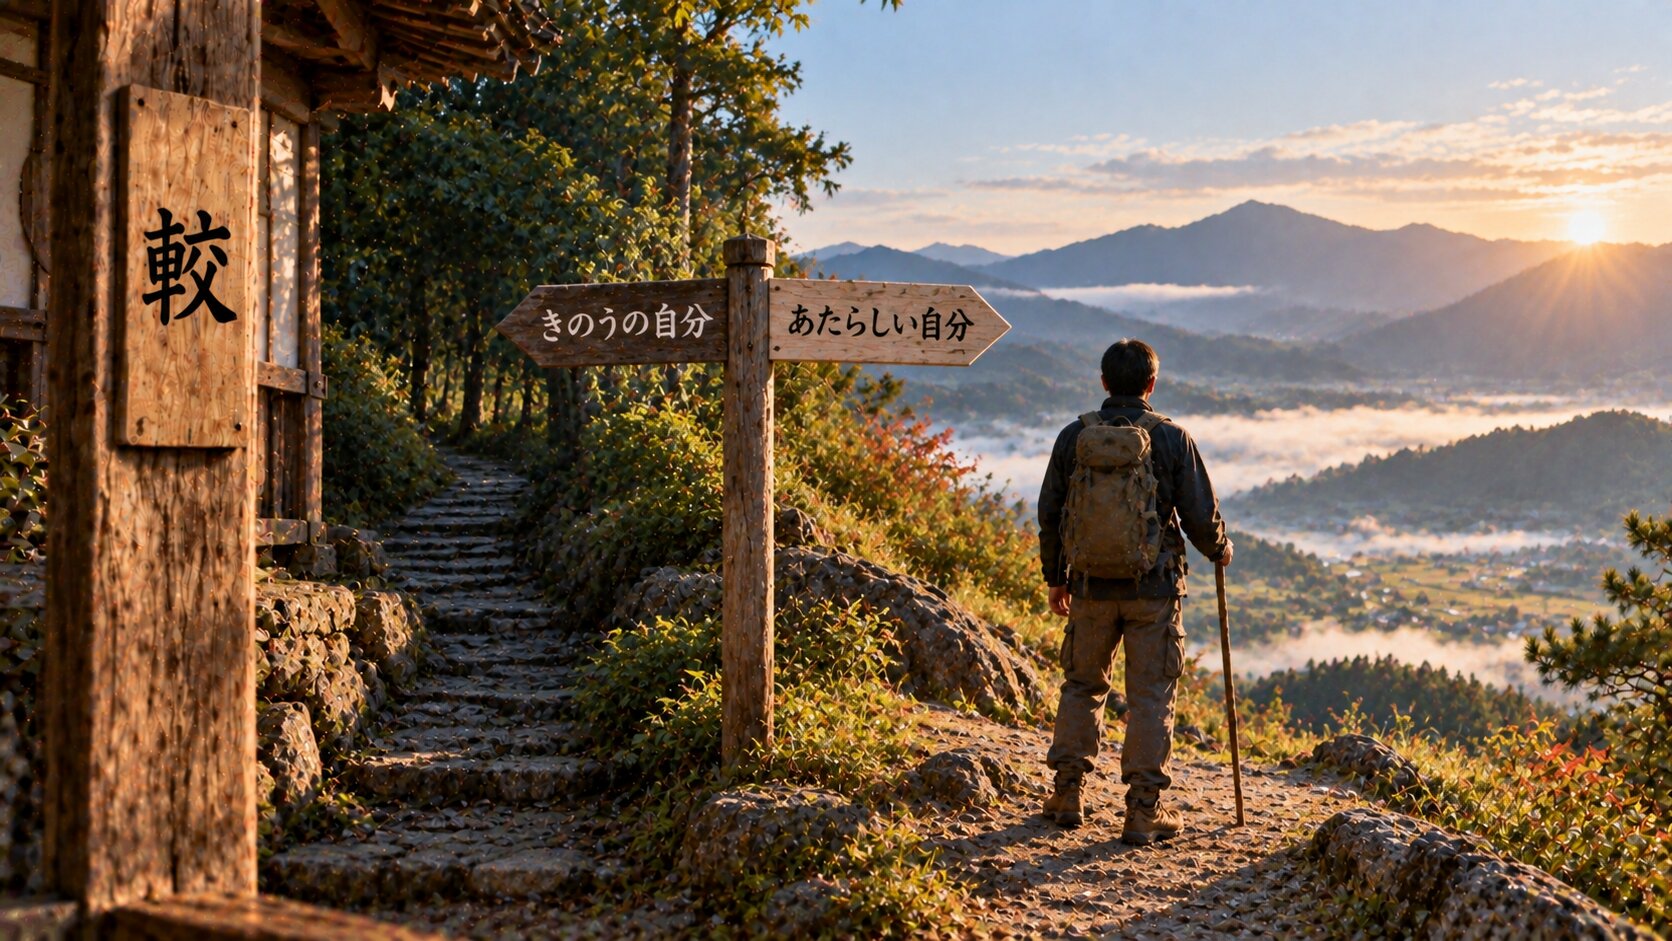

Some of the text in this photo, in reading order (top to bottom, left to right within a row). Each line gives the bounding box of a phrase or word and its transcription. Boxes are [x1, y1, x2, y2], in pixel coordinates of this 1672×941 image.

[142, 207, 238, 326] 較
[540, 303, 714, 342] きのうの自分
[788, 303, 975, 342] あたらしい自分
